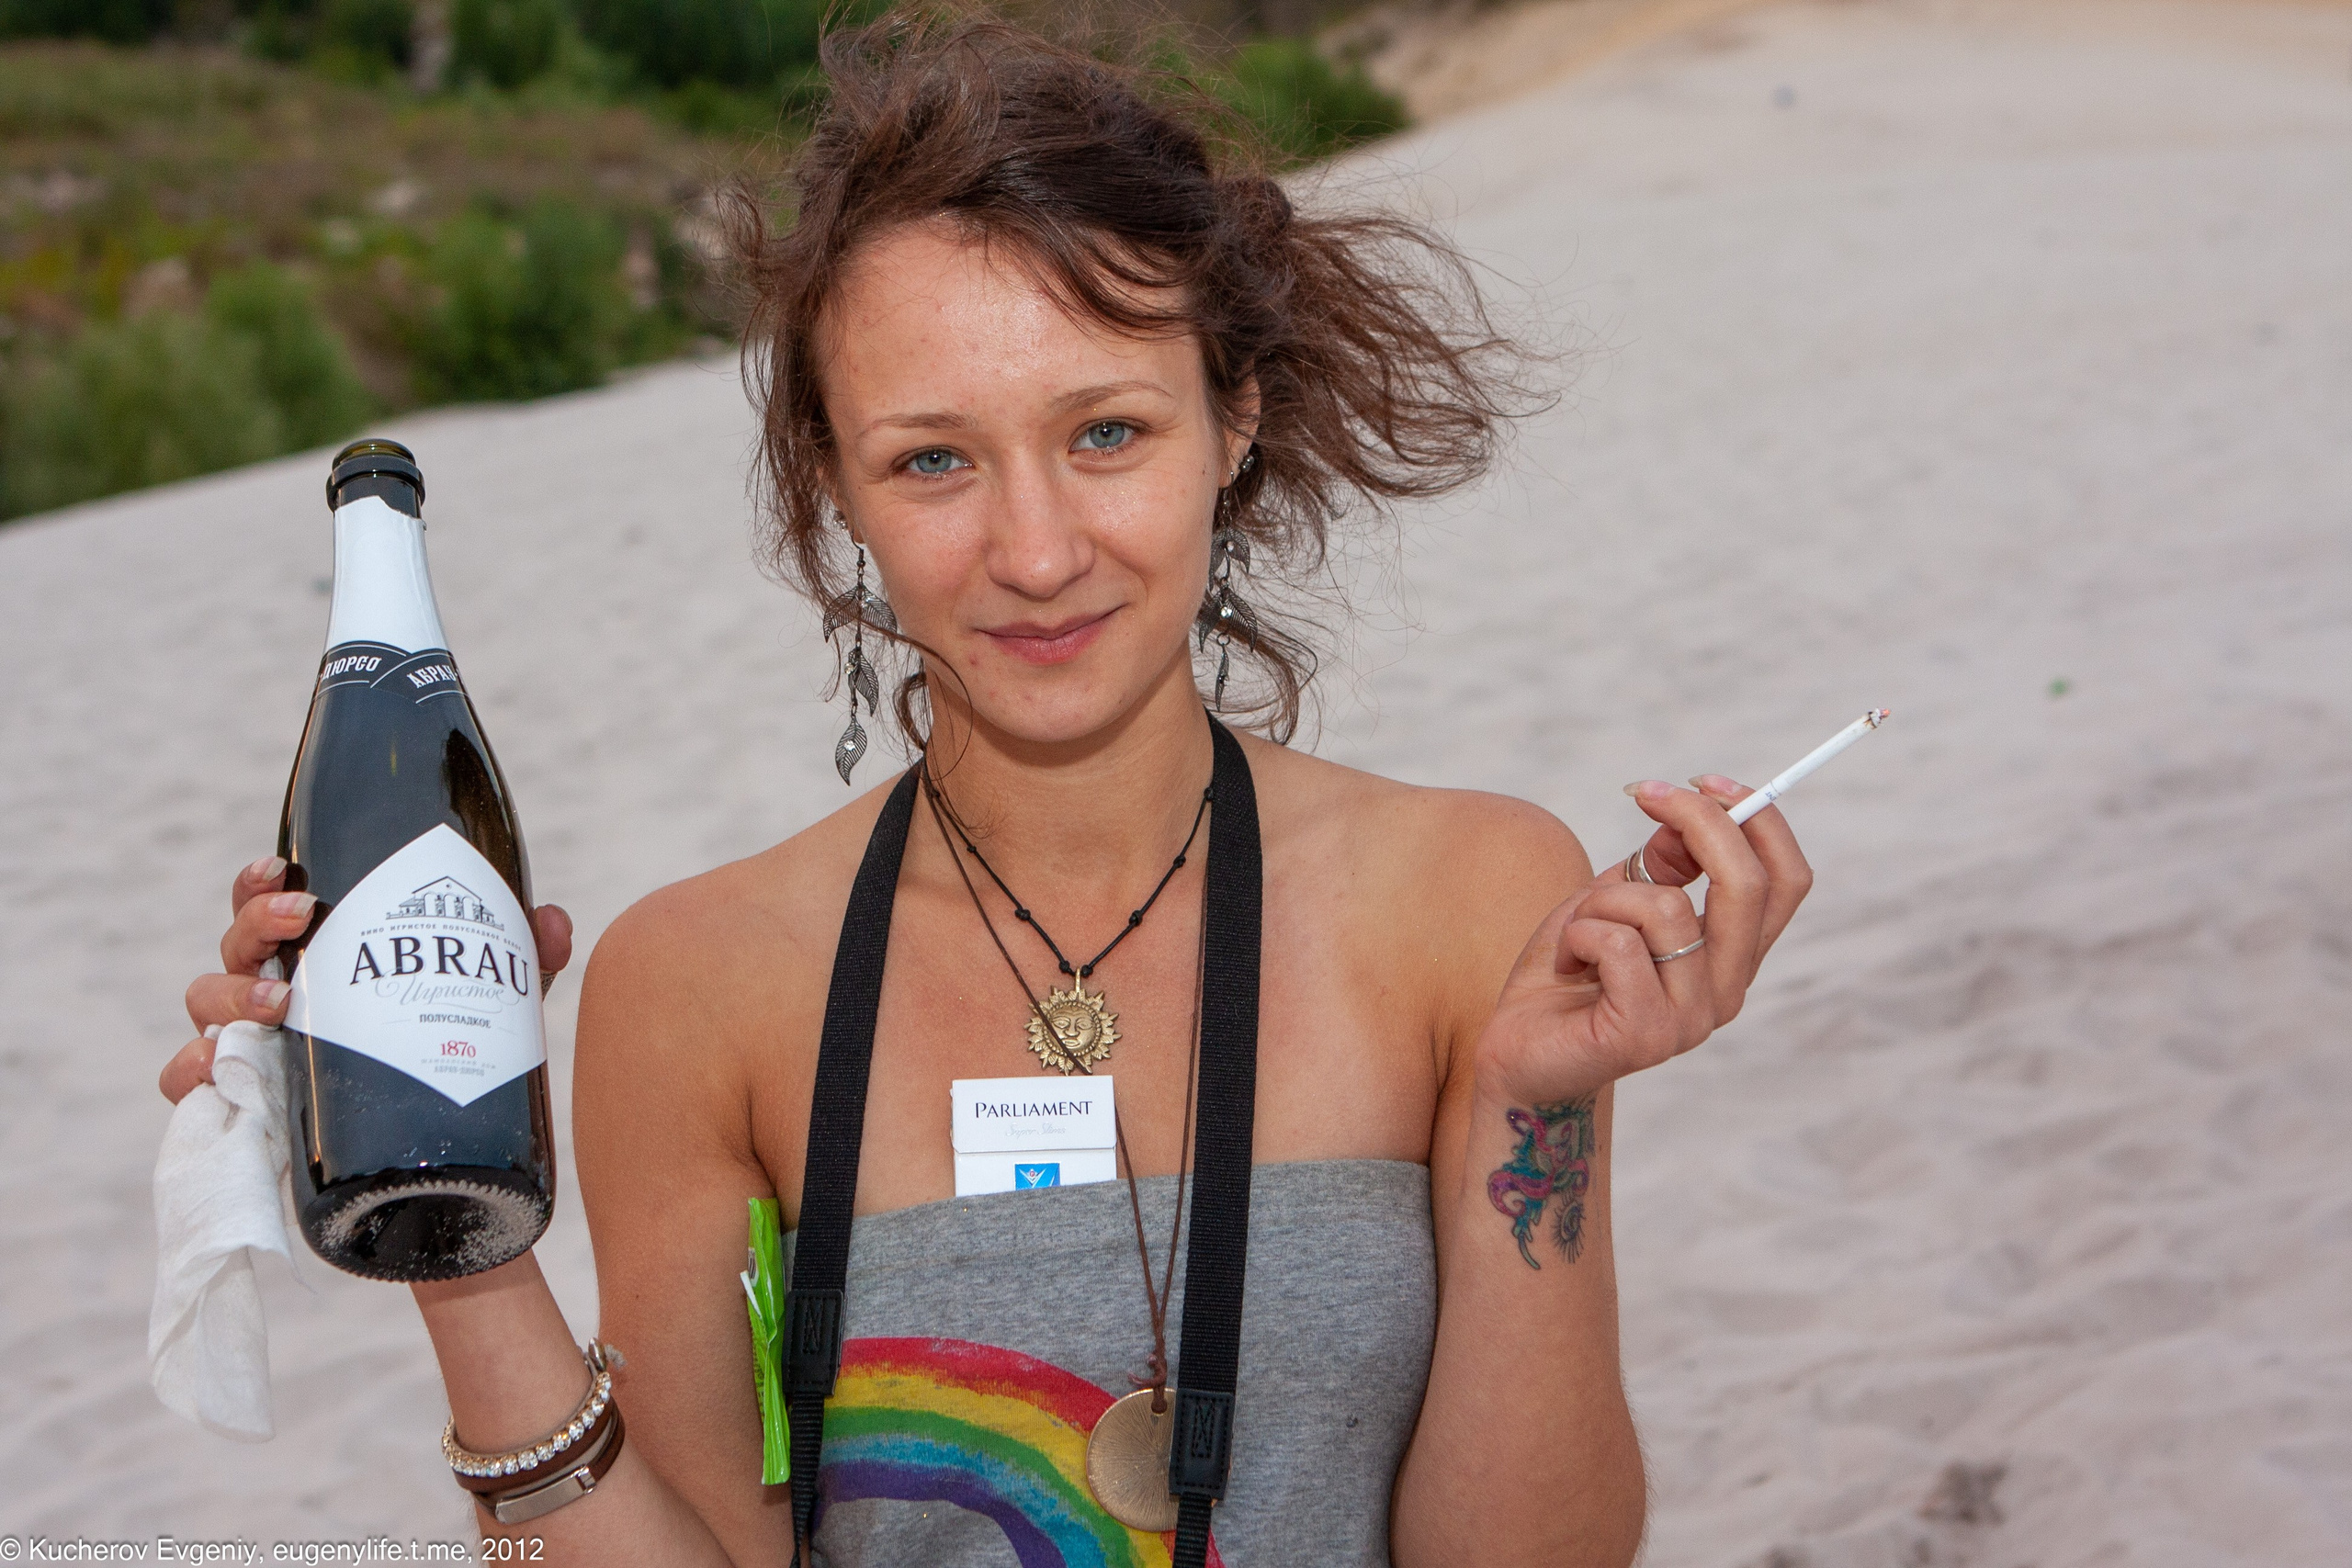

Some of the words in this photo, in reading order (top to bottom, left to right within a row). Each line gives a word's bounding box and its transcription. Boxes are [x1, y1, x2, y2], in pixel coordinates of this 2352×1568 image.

[390, 923, 436, 931] ИГРИСТОЕ
[443, 924, 500, 941] ПОЛУСЛАДКОЕ
[349, 935, 529, 997] ABRAU
[419, 1013, 492, 1029] ПОЛУСЛАДКОЕ
[440, 1040, 476, 1058] 1870
[975, 1100, 1092, 1119] PARLIAMENT
